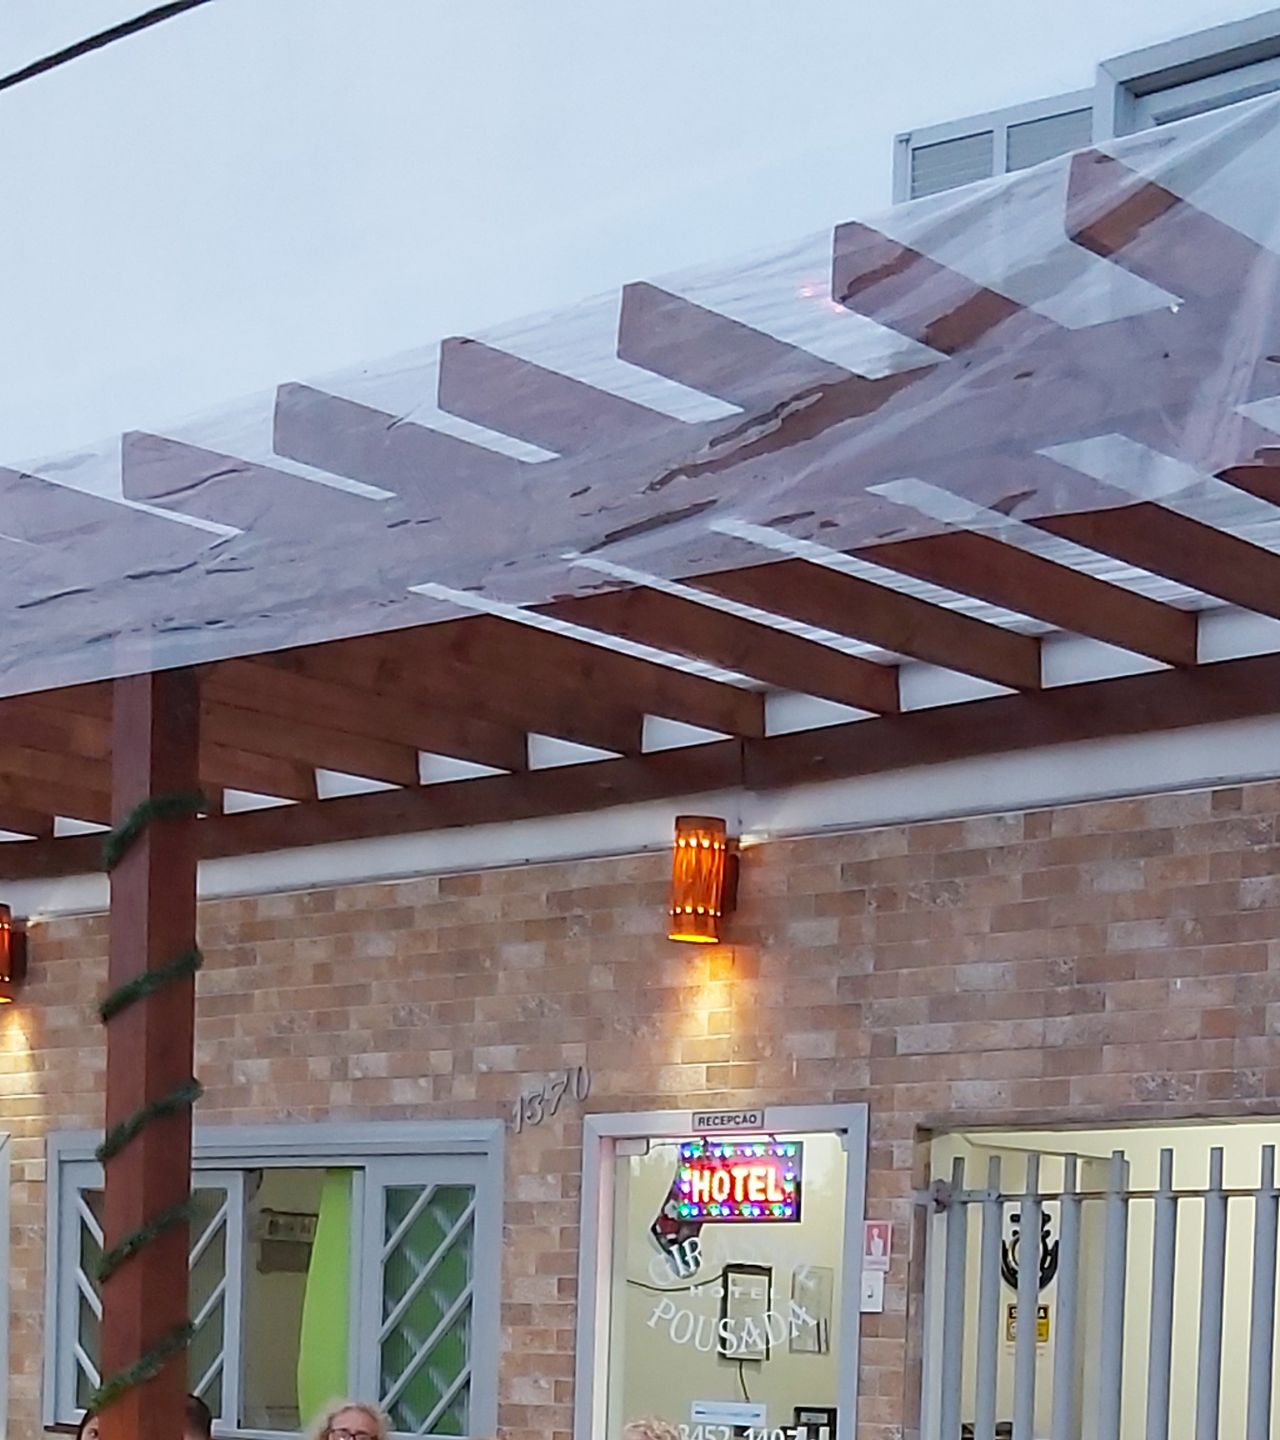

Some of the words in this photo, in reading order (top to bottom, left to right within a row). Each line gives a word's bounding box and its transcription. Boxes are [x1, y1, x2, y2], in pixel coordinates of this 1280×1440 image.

[691, 1166, 785, 1203] HOTEL
[690, 1285, 781, 1300] HOTEL
[646, 1297, 818, 1355] POUSADA
